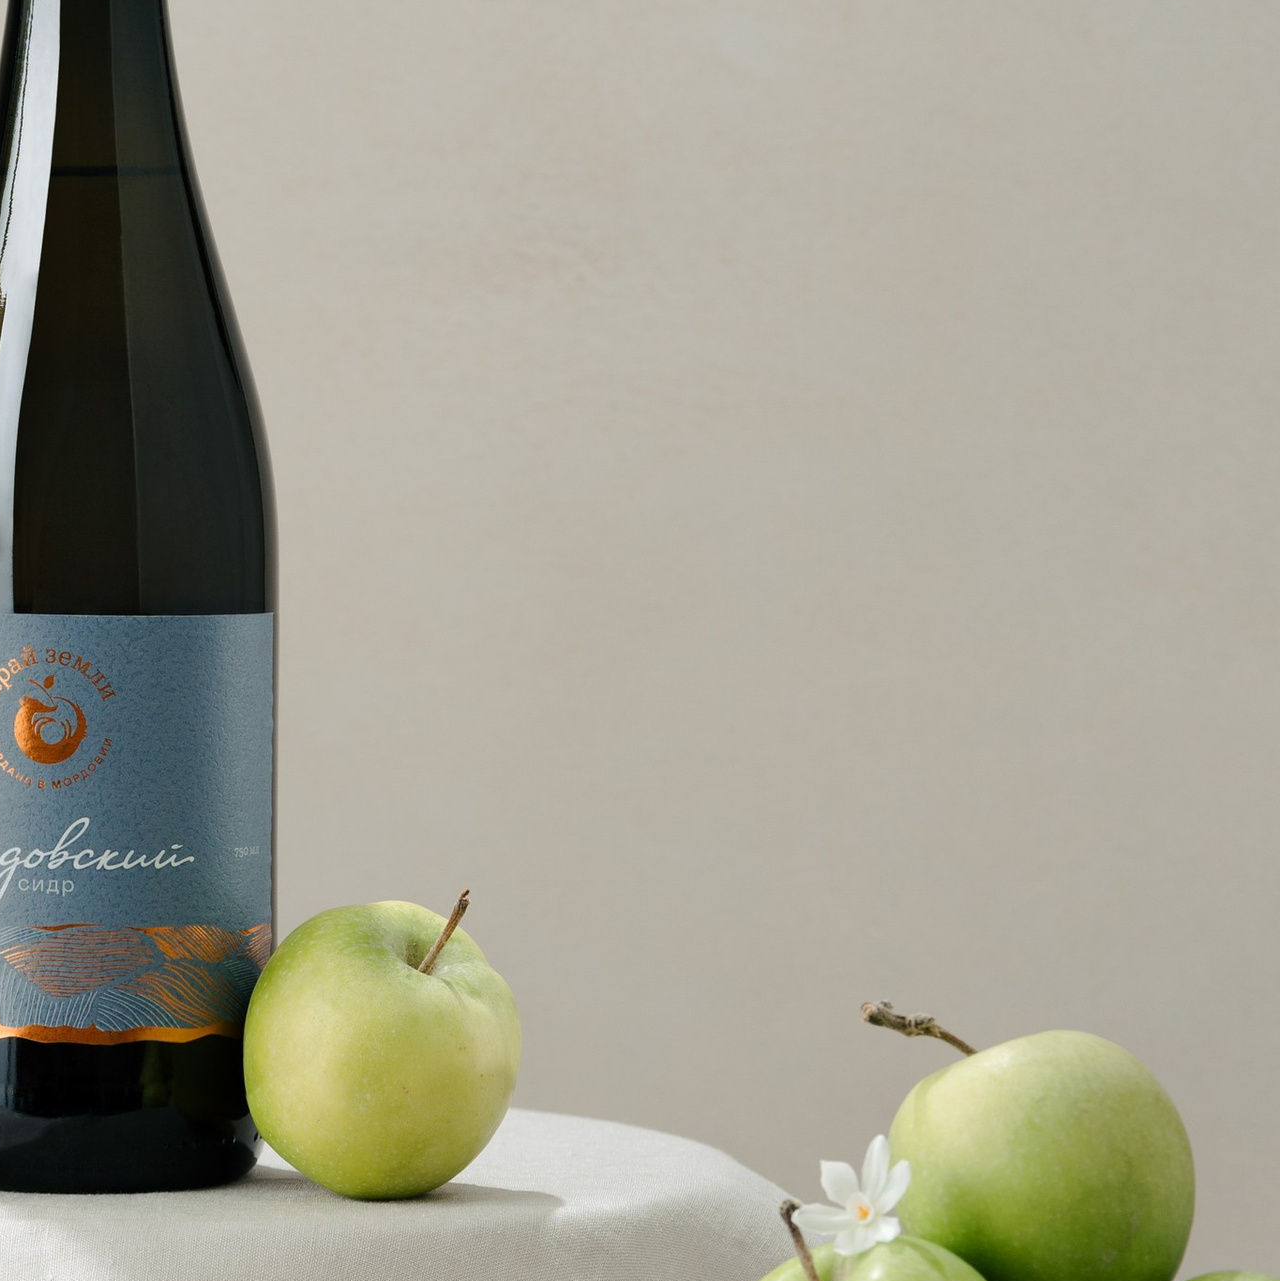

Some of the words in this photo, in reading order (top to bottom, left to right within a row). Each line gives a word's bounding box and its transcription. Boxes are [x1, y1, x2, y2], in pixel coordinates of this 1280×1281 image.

[45, 648, 116, 702] земли
[234, 846, 249, 858] 750
[18, 878, 75, 896] сидр
